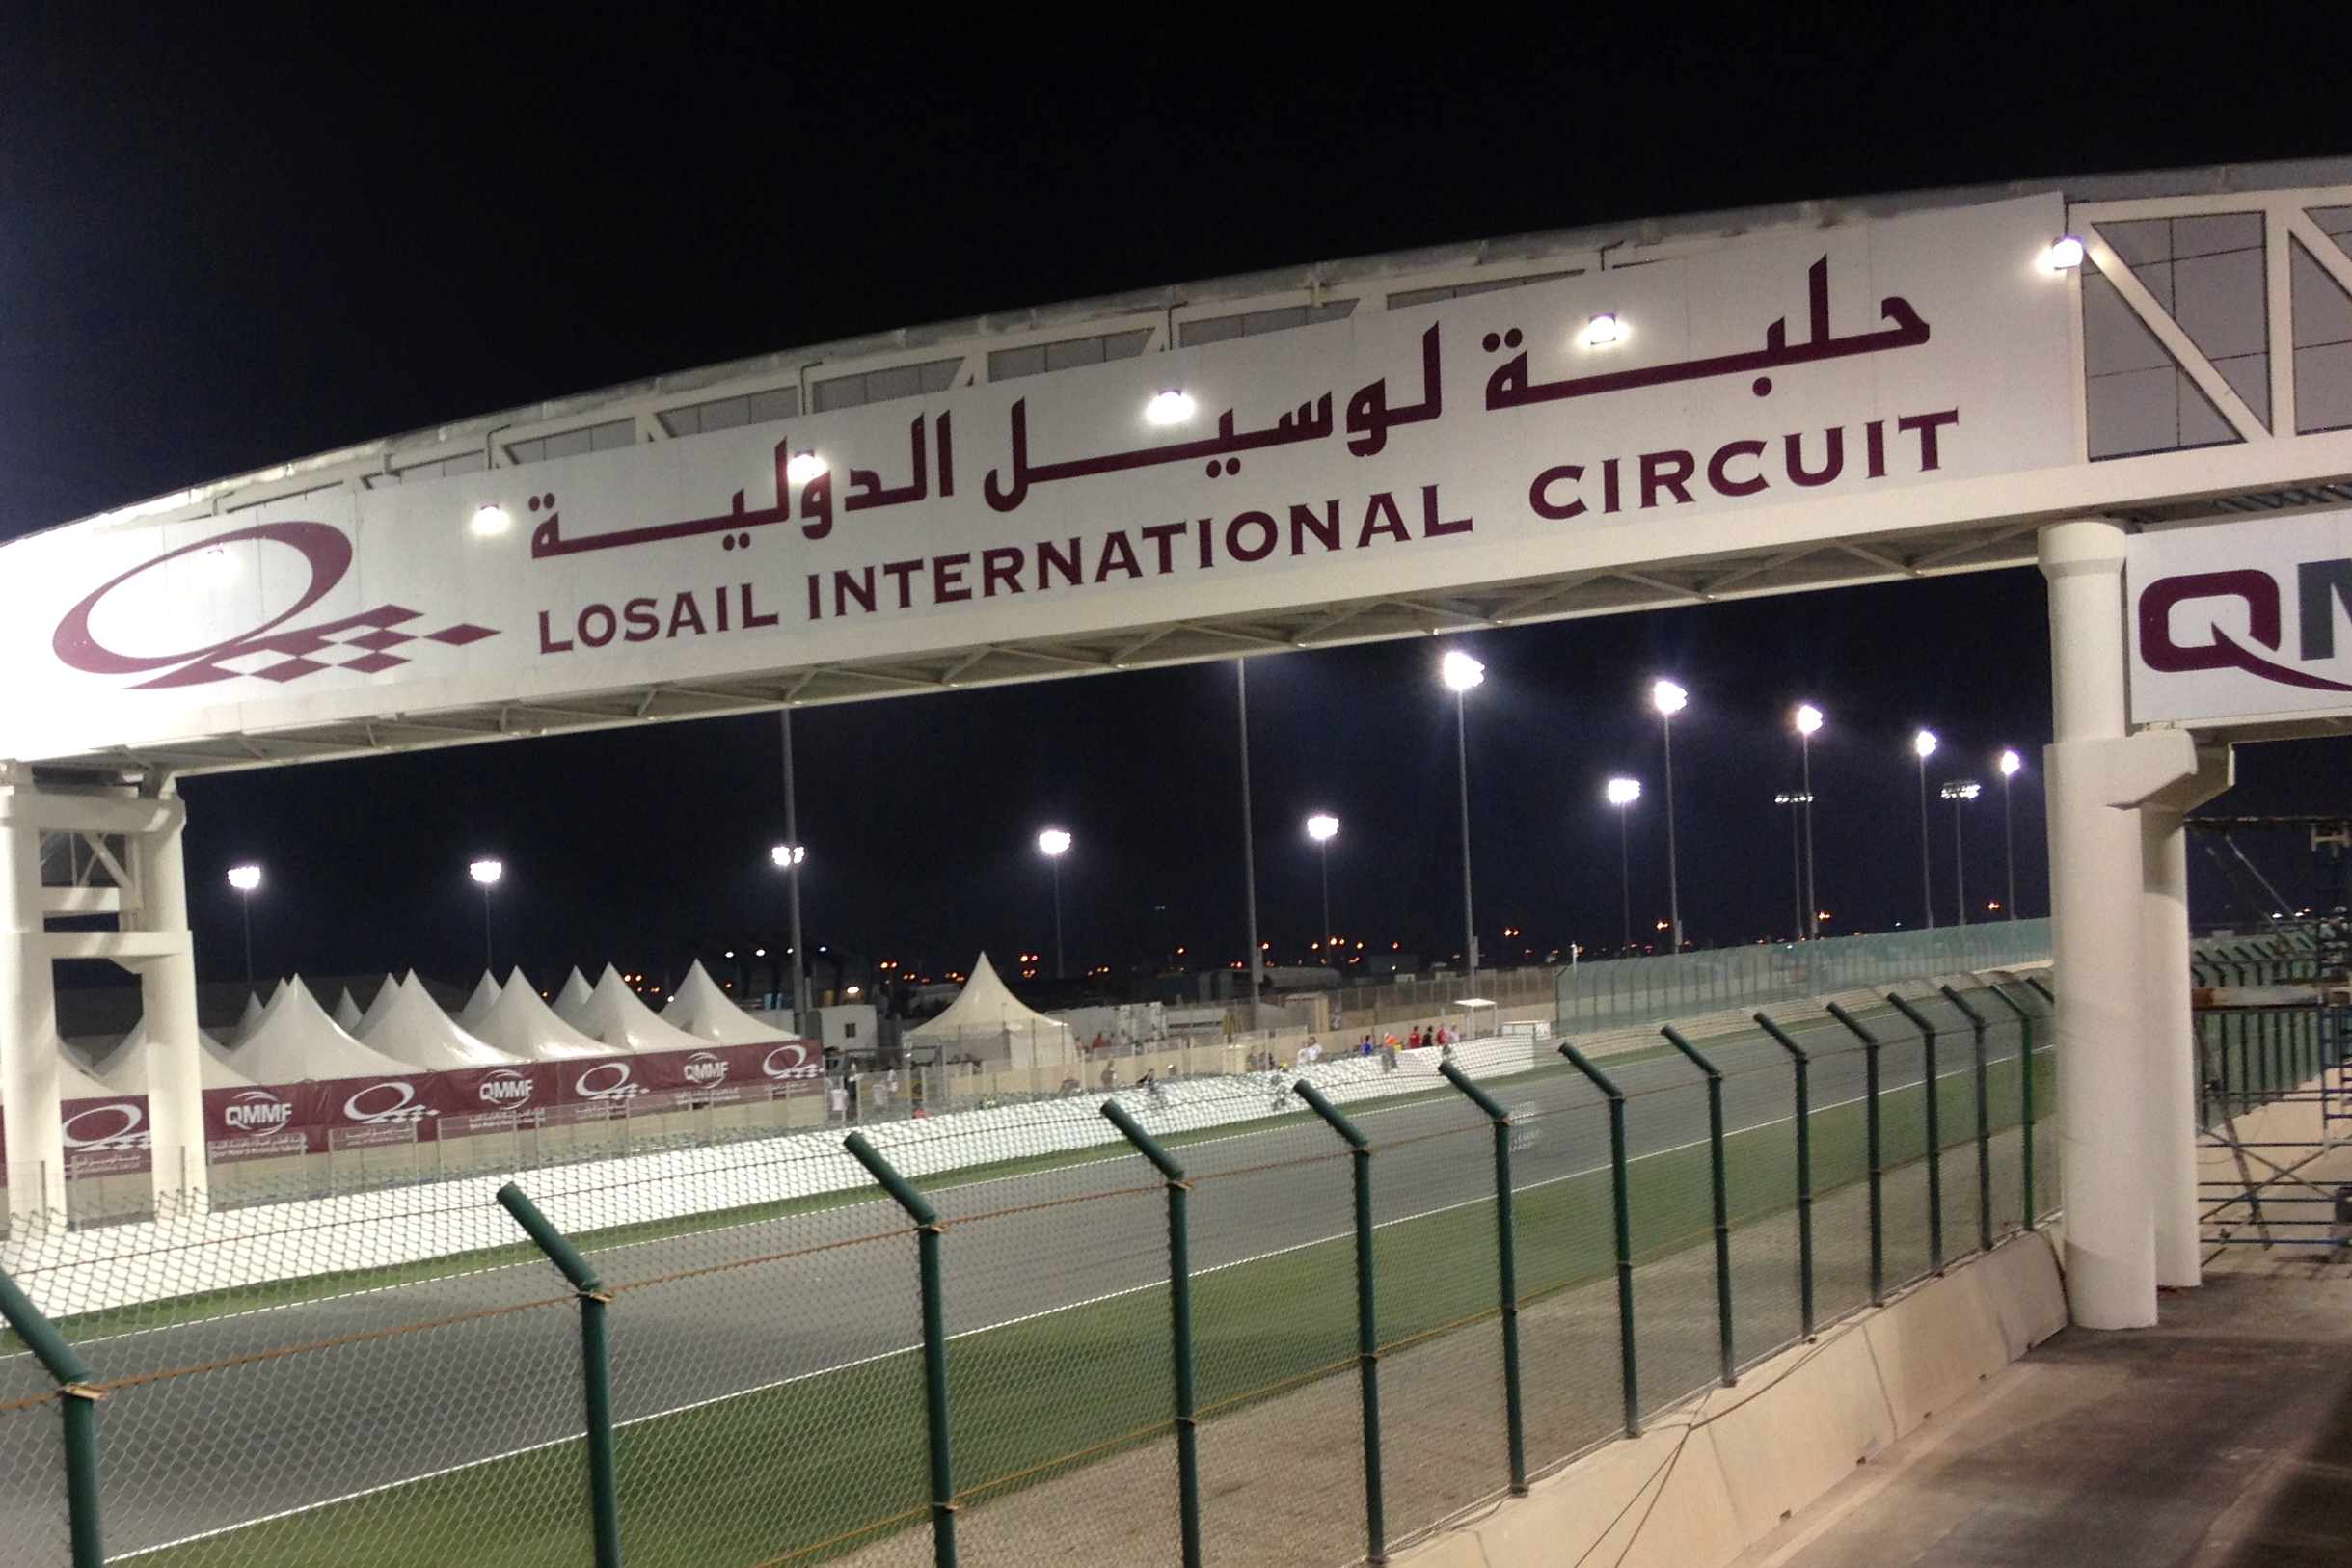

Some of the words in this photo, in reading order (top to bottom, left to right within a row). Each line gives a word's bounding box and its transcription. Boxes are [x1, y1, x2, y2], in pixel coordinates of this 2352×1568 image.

[1485, 254, 1931, 411] حلبة
[527, 408, 953, 559] الدولية
[984, 320, 1443, 513] لوسيل
[537, 582, 779, 654] LOSAIL
[807, 484, 1473, 620] INTERNATIONAL
[1528, 406, 1960, 520] CIRCUIT
[225, 1103, 292, 1130] QMMF
[479, 1079, 533, 1105] QMMF
[683, 1061, 729, 1084] QMMF
